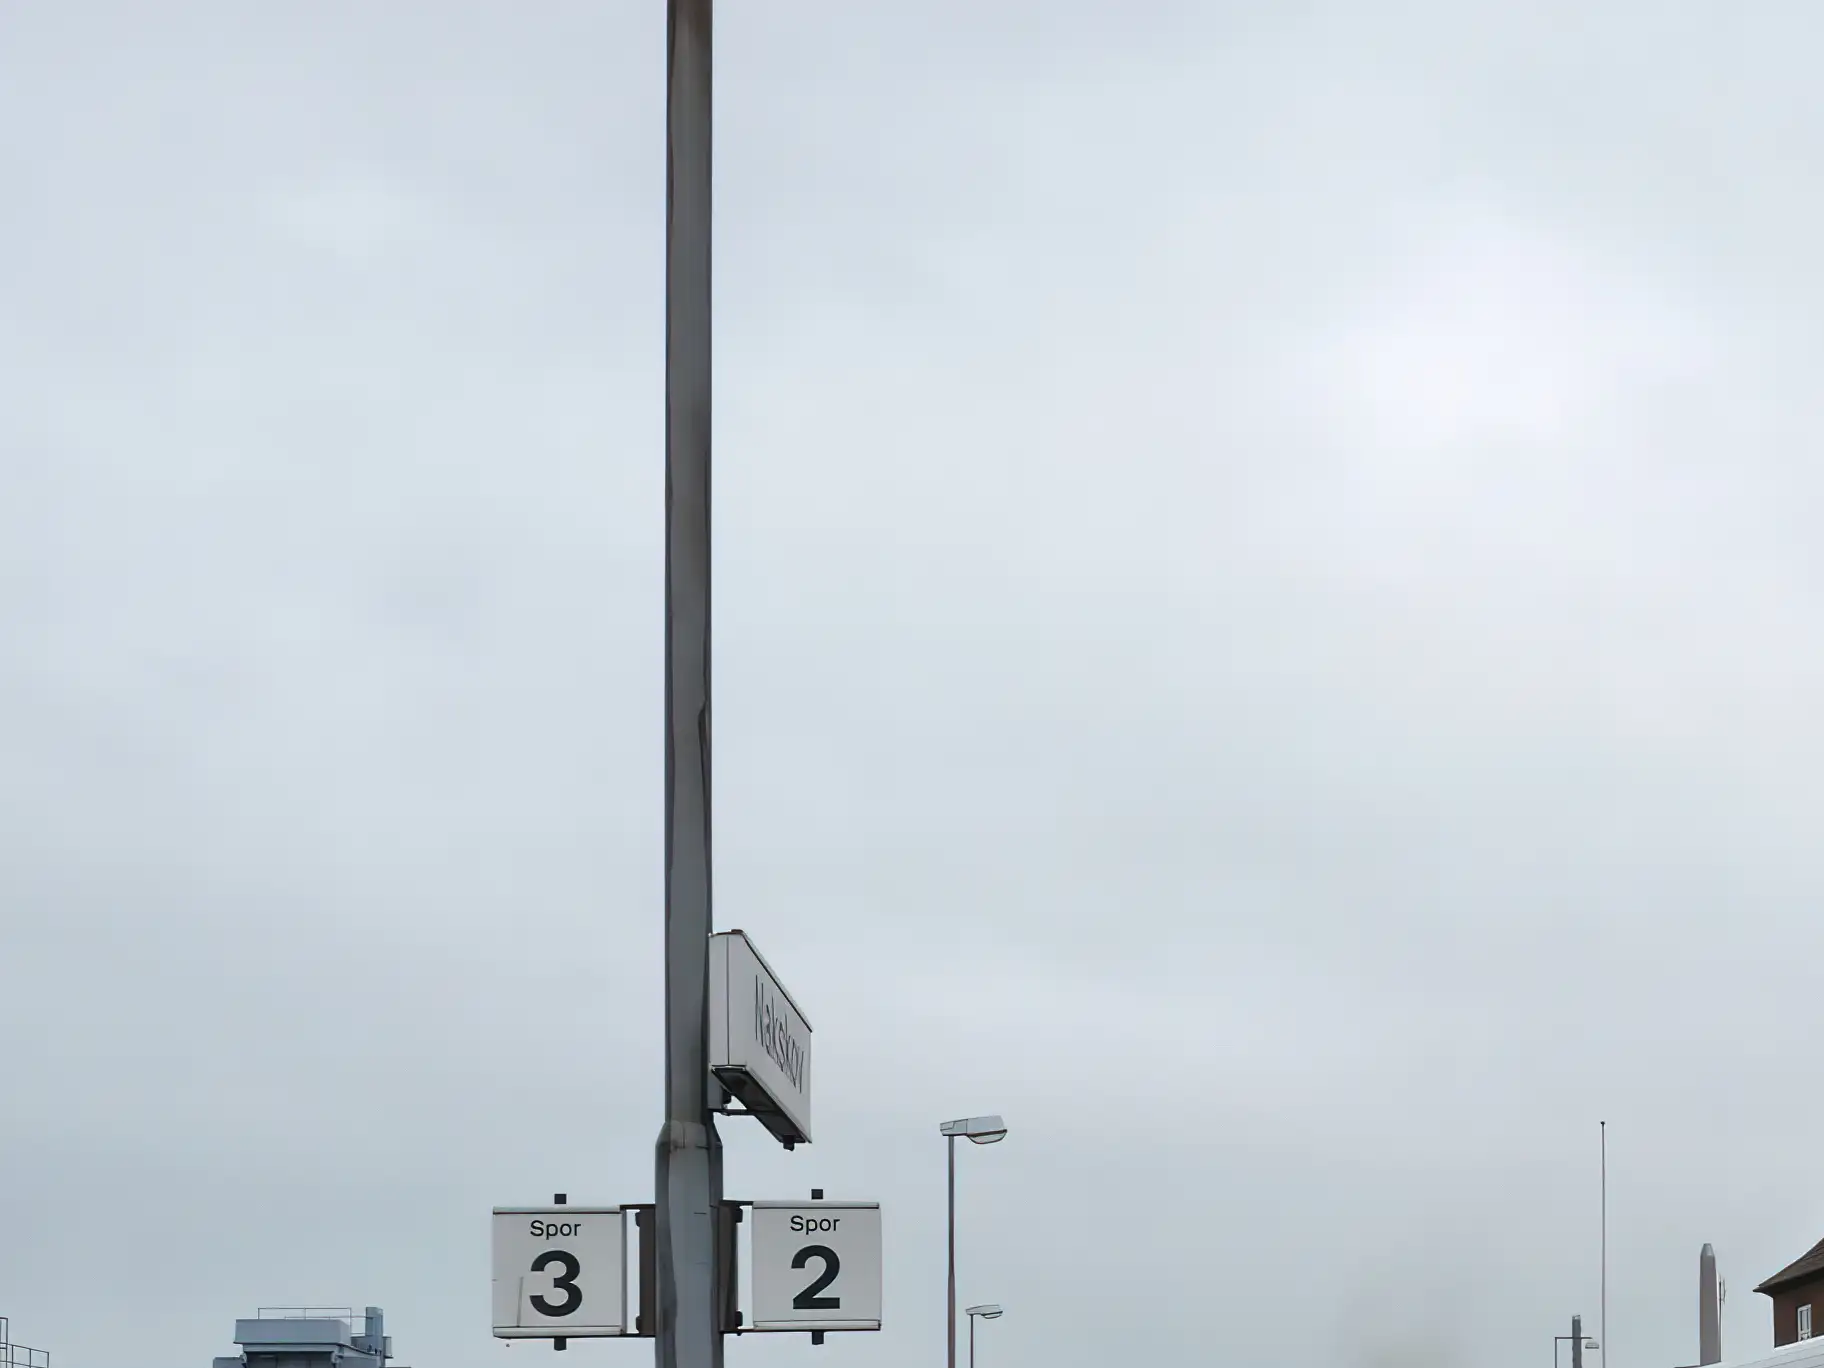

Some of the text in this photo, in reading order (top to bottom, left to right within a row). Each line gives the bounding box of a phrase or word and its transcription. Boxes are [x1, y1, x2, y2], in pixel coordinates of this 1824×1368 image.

[755, 974, 804, 1094] Nakskov
[530, 1220, 581, 1240] Spor
[790, 1215, 841, 1235] Spor
[529, 1250, 583, 1317] 3
[791, 1245, 840, 1309] 2
